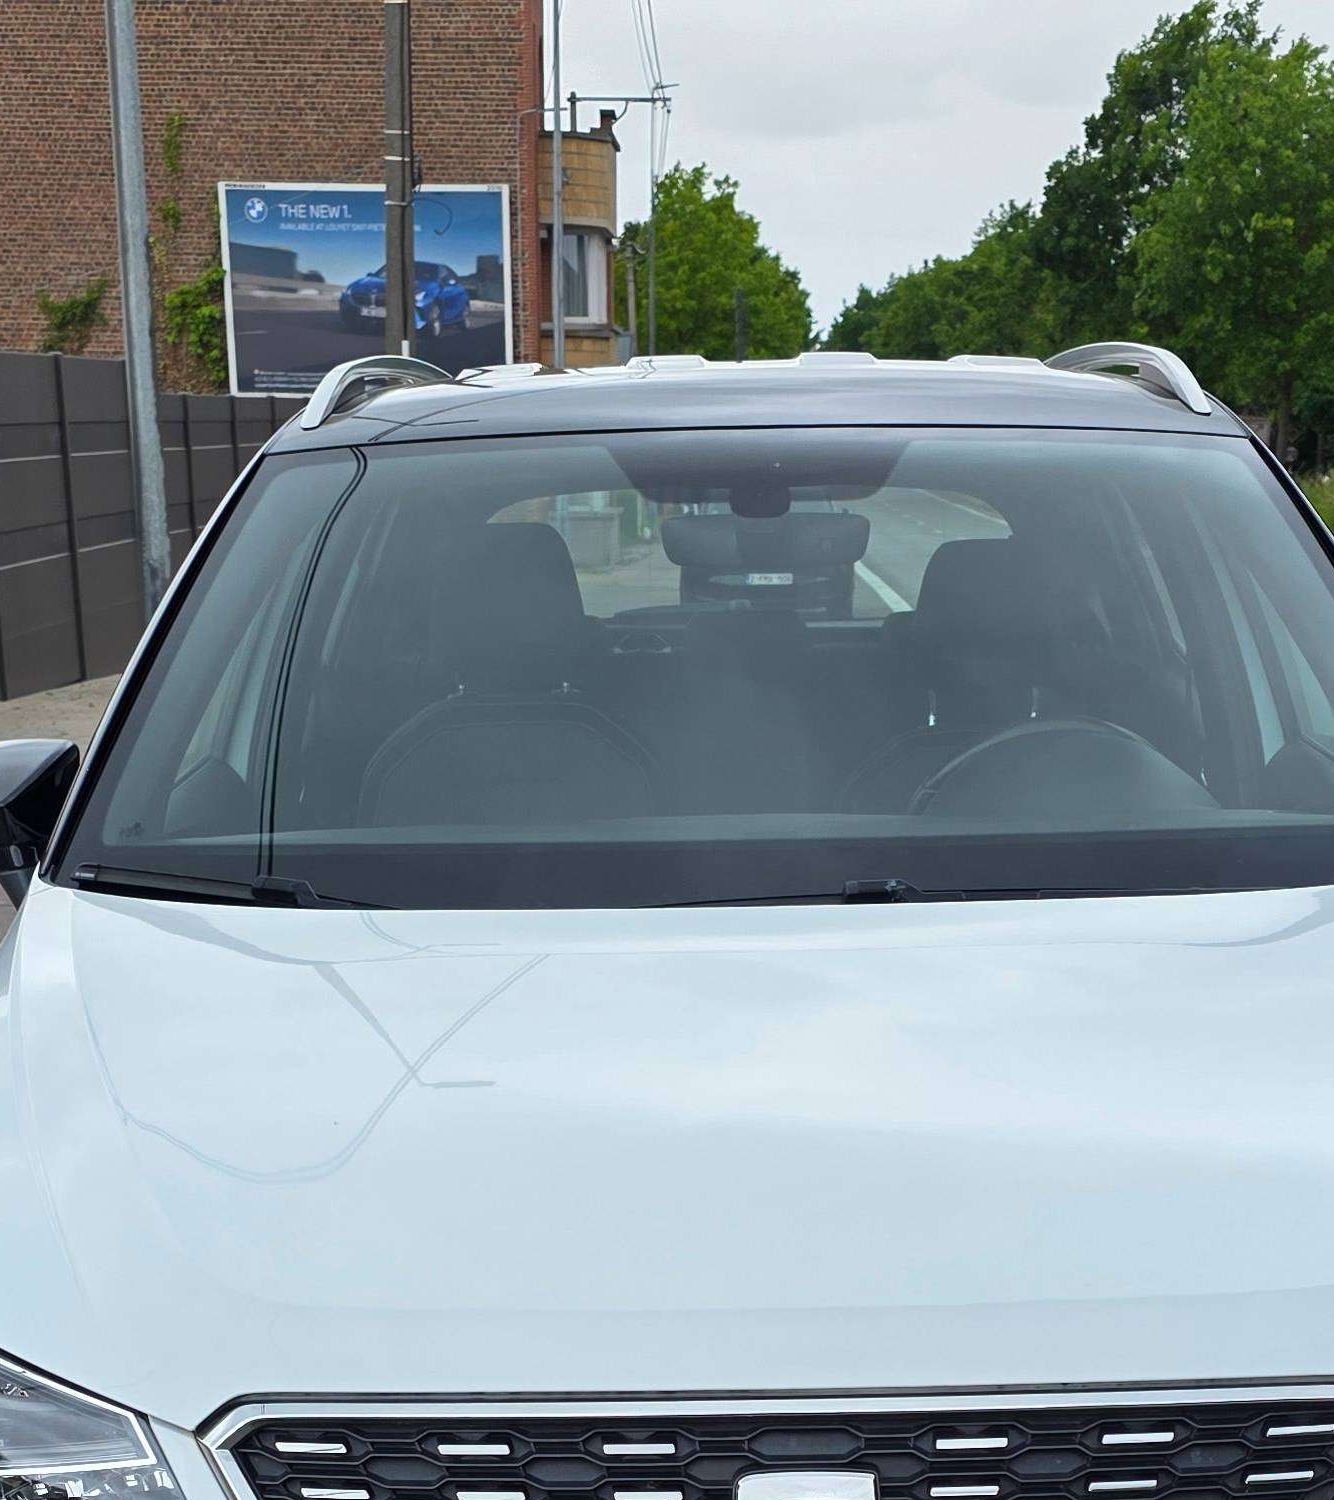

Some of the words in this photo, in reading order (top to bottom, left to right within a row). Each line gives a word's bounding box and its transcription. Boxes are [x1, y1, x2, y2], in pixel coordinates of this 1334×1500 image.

[279, 203, 307, 218] THE
[309, 204, 341, 219] NEW
[342, 204, 352, 218] 1.
[279, 222, 314, 231] AVAILABLE
